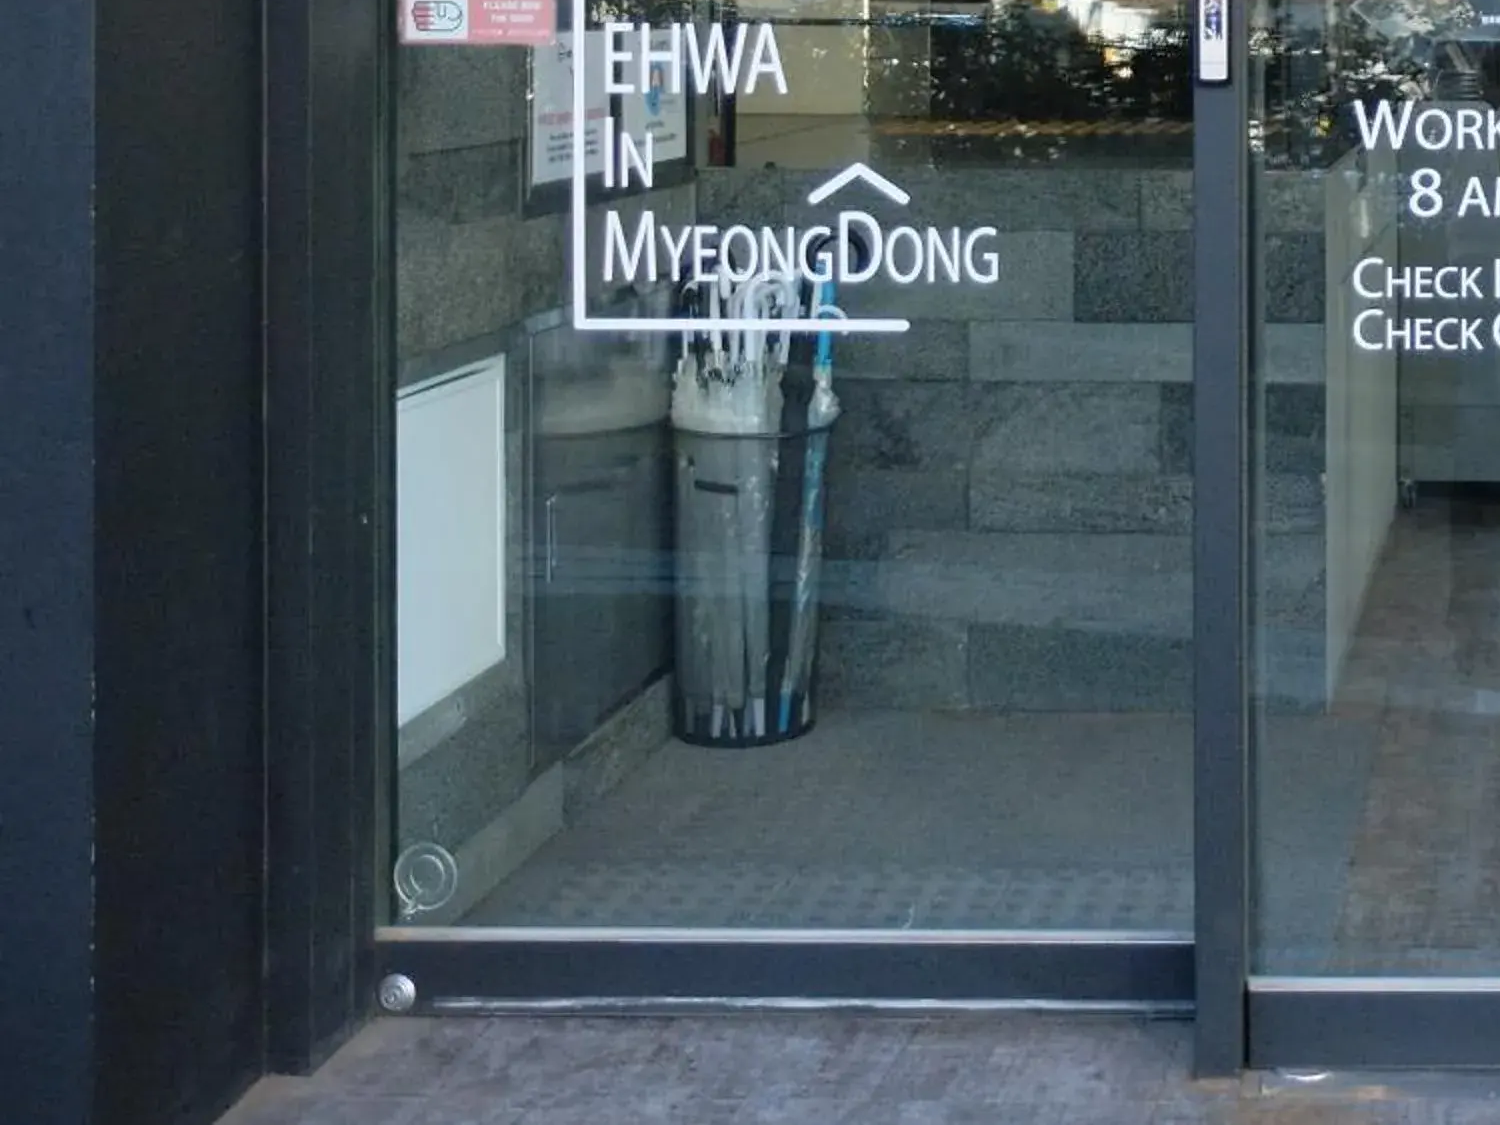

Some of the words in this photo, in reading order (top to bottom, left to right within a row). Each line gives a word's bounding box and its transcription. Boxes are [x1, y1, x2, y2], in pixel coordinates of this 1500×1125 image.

[604, 22, 788, 96] EHWA
[603, 117, 654, 188] IN
[1408, 167, 1443, 218] 8
[1352, 257, 1483, 300] CHECK
[1352, 309, 1483, 351] CHECK
